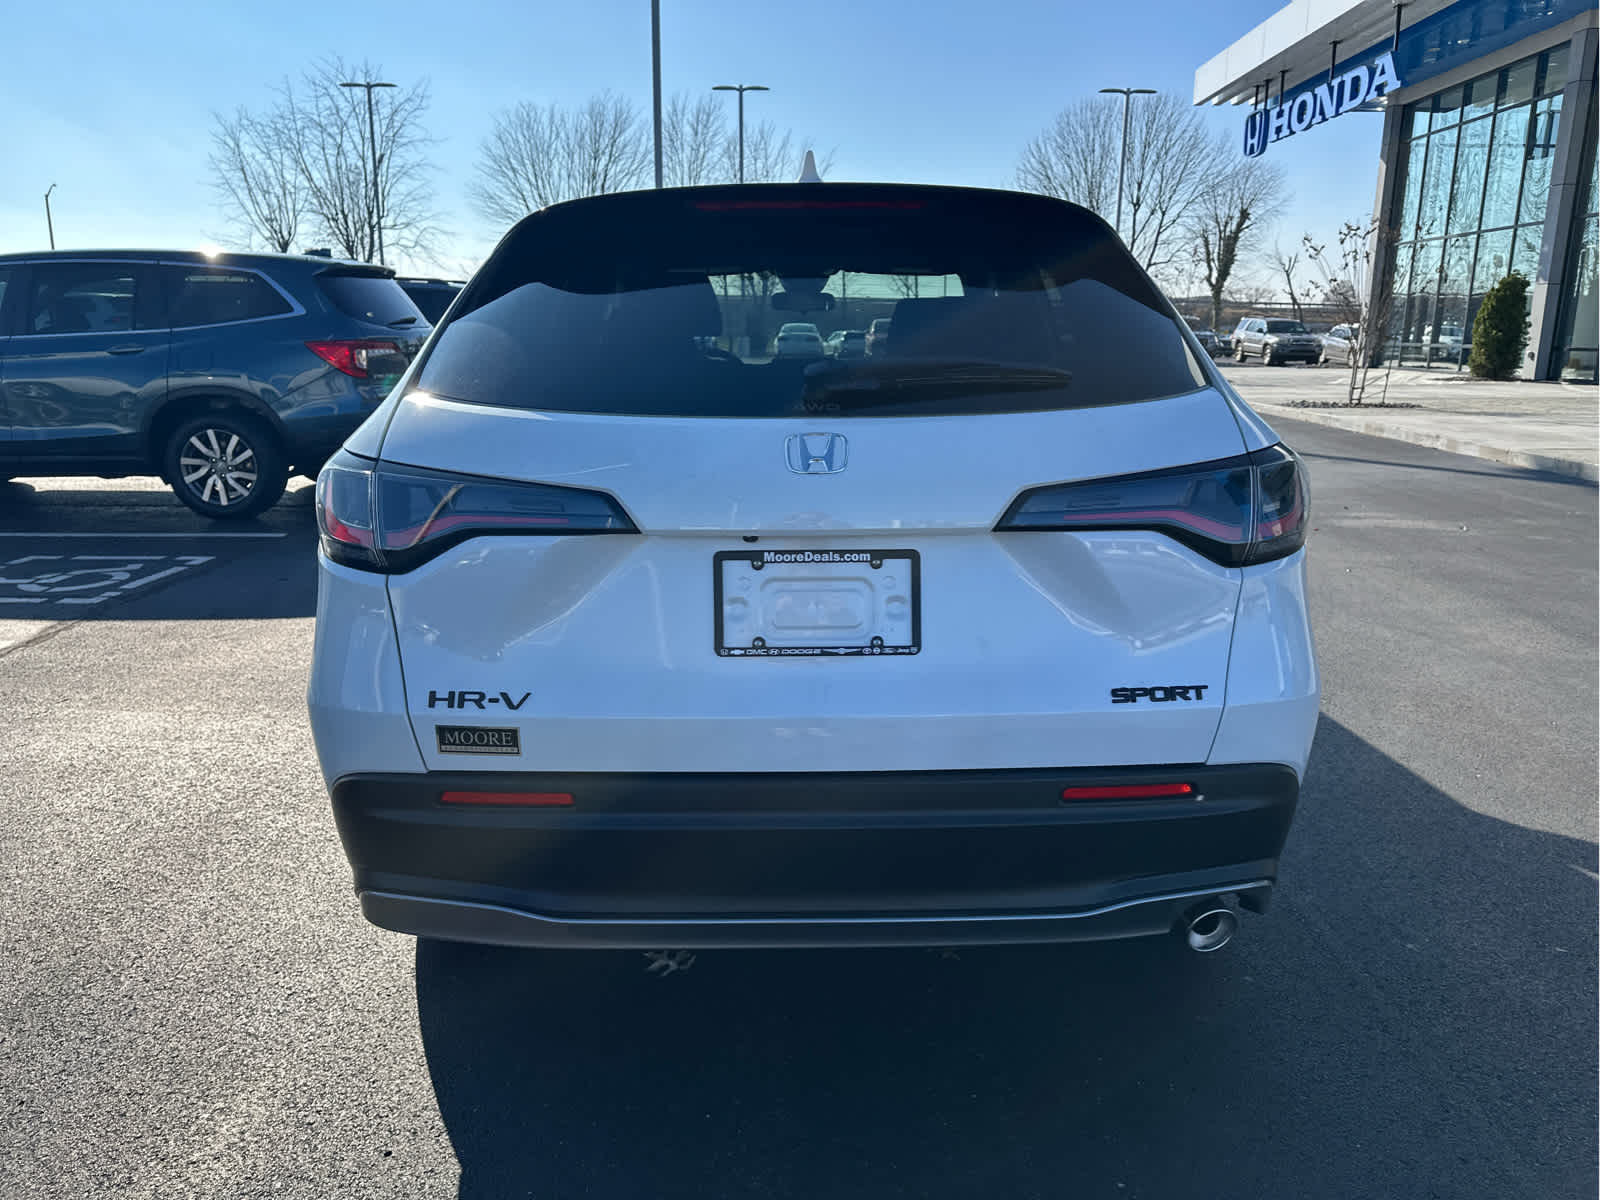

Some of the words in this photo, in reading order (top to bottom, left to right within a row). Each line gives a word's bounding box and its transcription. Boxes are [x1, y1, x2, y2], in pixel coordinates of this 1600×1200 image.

[1269, 51, 1401, 142] HONDA
[763, 551, 871, 562] MooreDeals.com
[428, 690, 532, 710] HR-V
[1111, 684, 1208, 703] SPORT
[445, 730, 513, 745] MOORE
